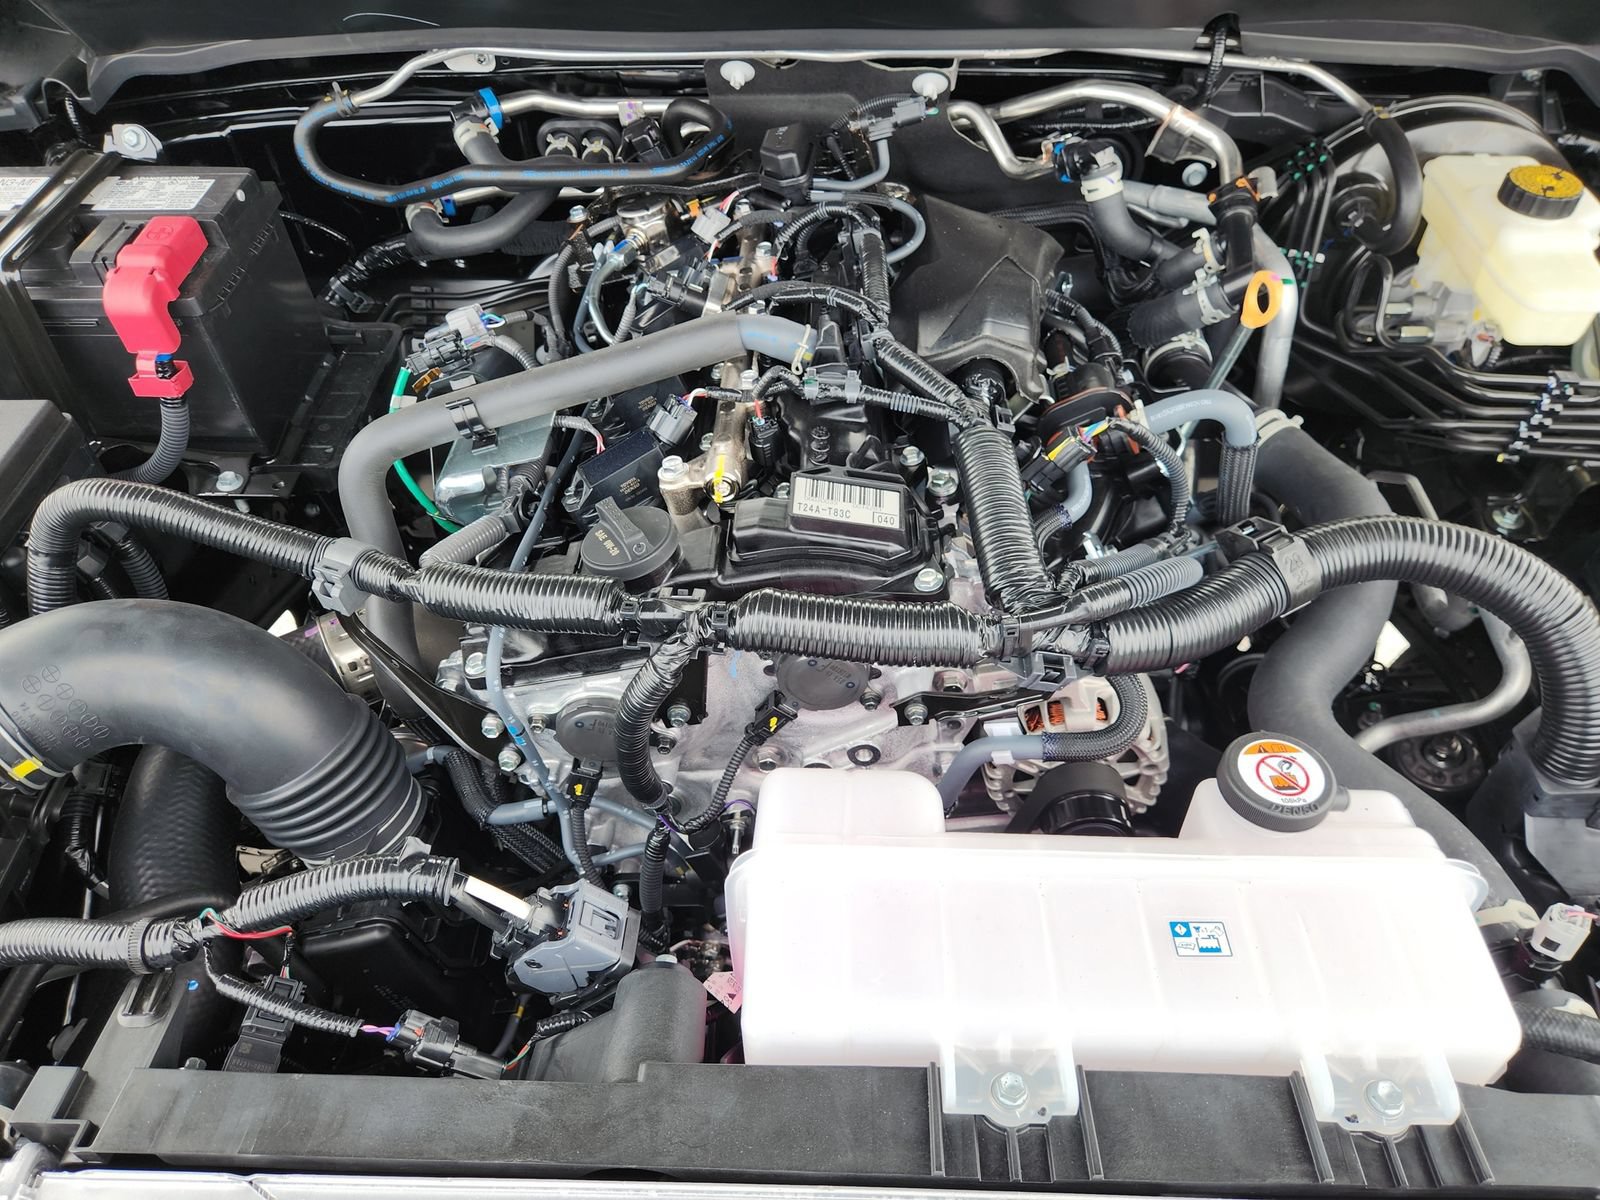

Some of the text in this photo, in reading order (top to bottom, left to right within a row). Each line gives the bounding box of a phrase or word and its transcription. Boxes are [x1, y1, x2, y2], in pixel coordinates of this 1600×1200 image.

[797, 503, 851, 519] T24A-T83C
[877, 514, 895, 526] 040
[595, 530, 608, 541] SAE
[1270, 804, 1320, 816] DENSO
